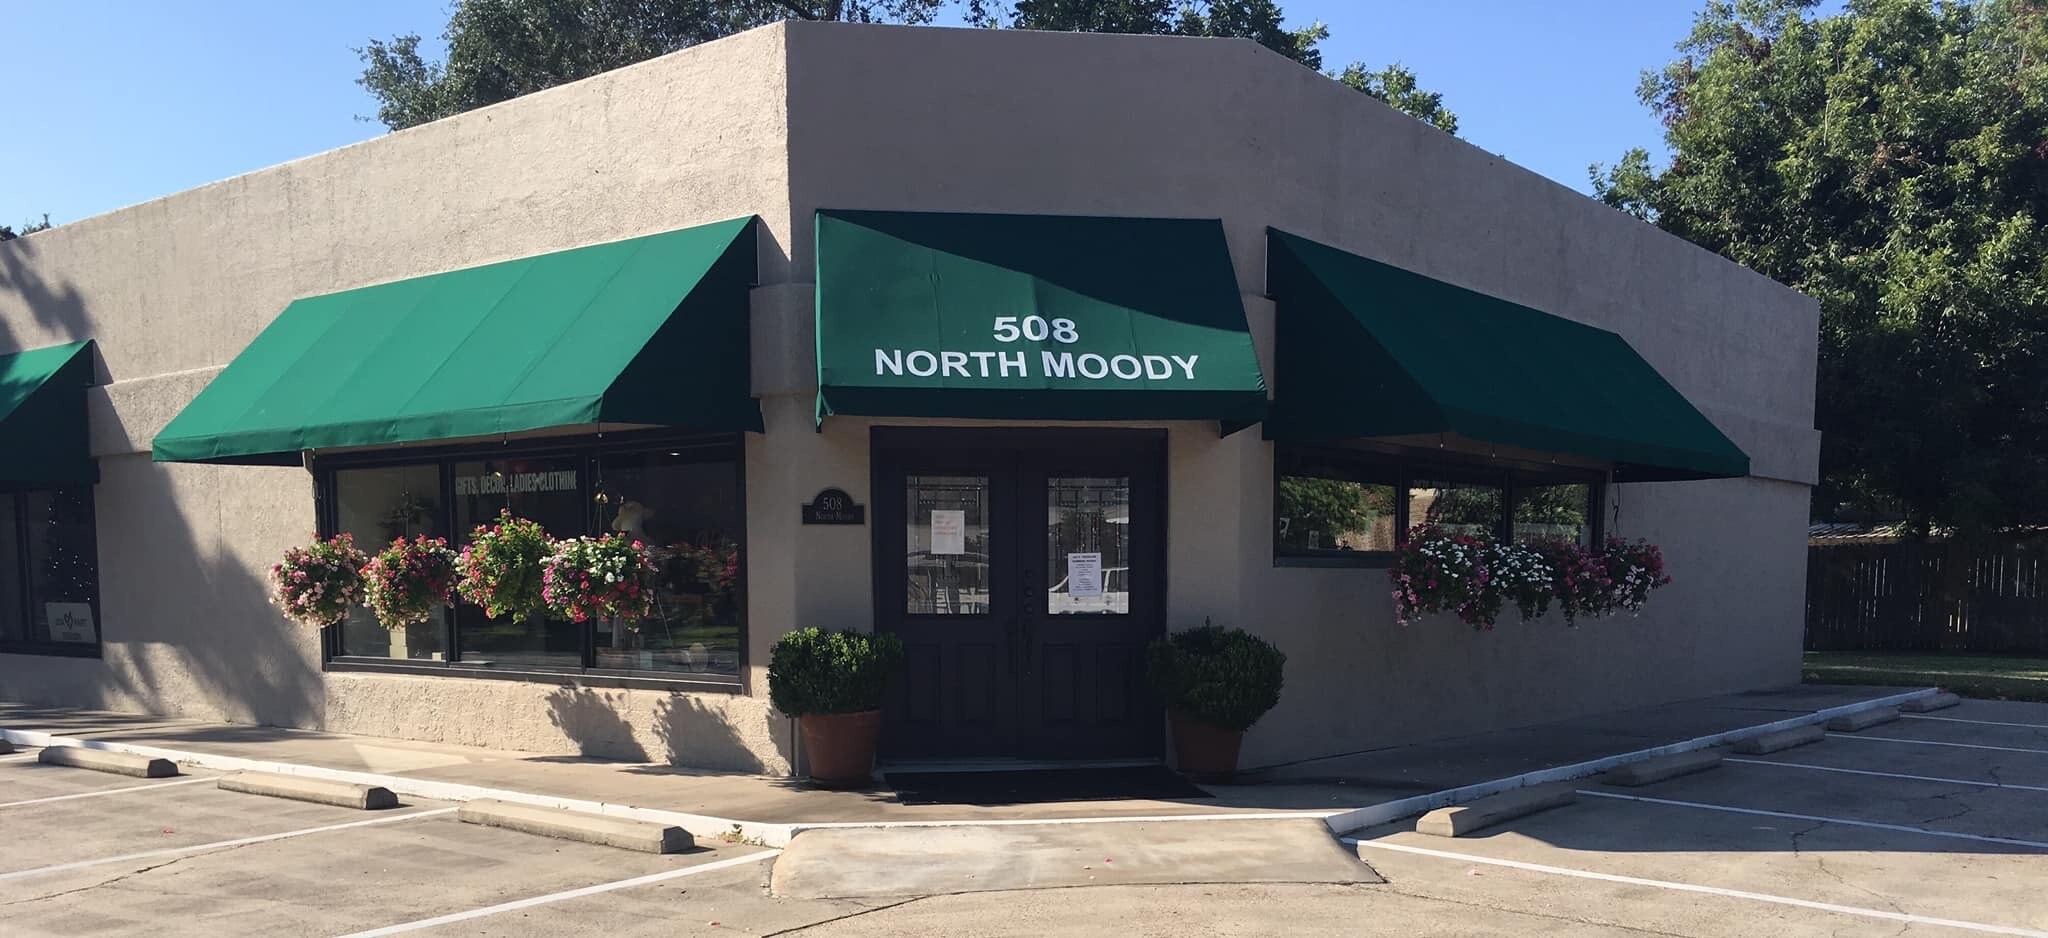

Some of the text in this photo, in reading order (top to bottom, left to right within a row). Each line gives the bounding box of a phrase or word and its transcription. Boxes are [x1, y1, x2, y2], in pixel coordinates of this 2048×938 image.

[993, 315, 1079, 344] 508
[874, 348, 1199, 380] NORTH MOODY
[823, 496, 842, 511] 508
